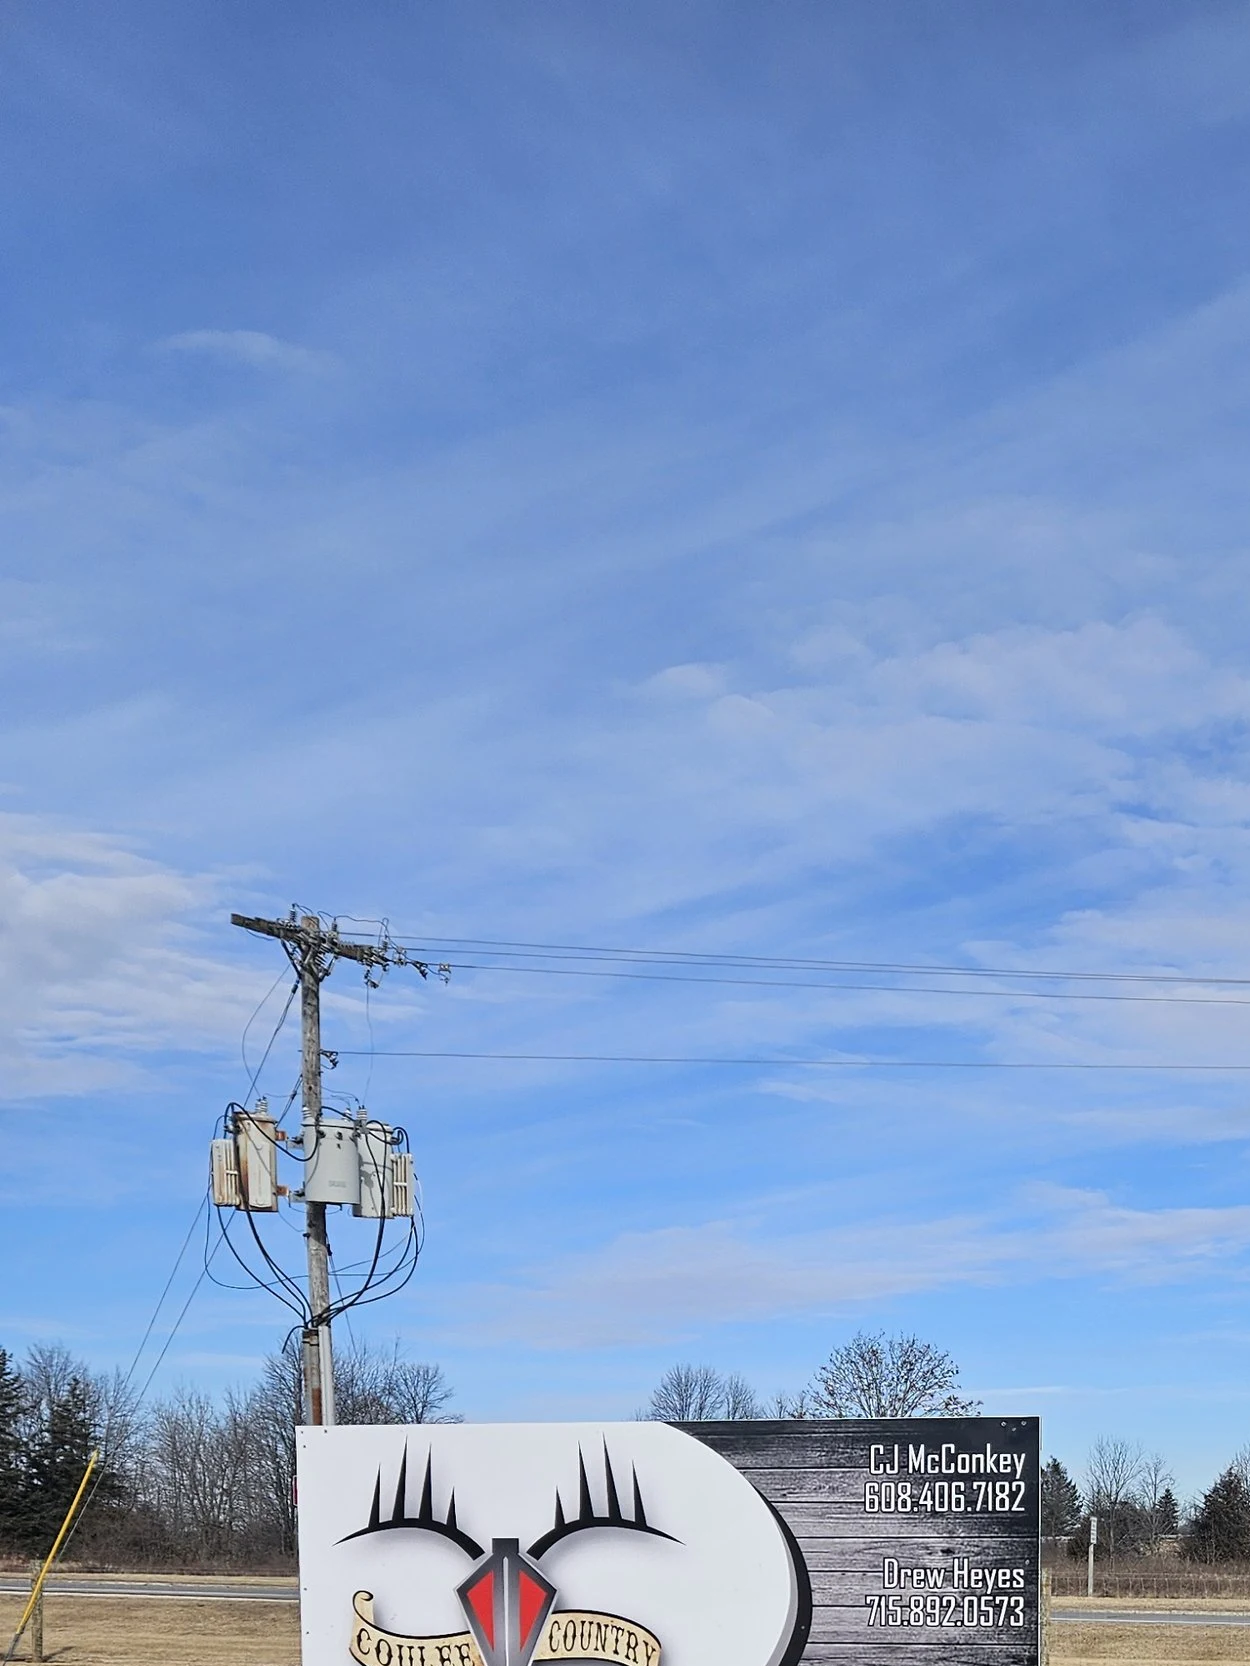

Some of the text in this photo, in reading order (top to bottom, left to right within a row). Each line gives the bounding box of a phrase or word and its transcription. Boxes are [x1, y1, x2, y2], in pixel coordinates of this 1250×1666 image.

[869, 1442, 1026, 1480] CJ McConkey
[864, 1481, 1026, 1513] 608.406.7182
[883, 1557, 1026, 1595] Drew Heyes
[866, 1595, 1025, 1627] 715.892.0573
